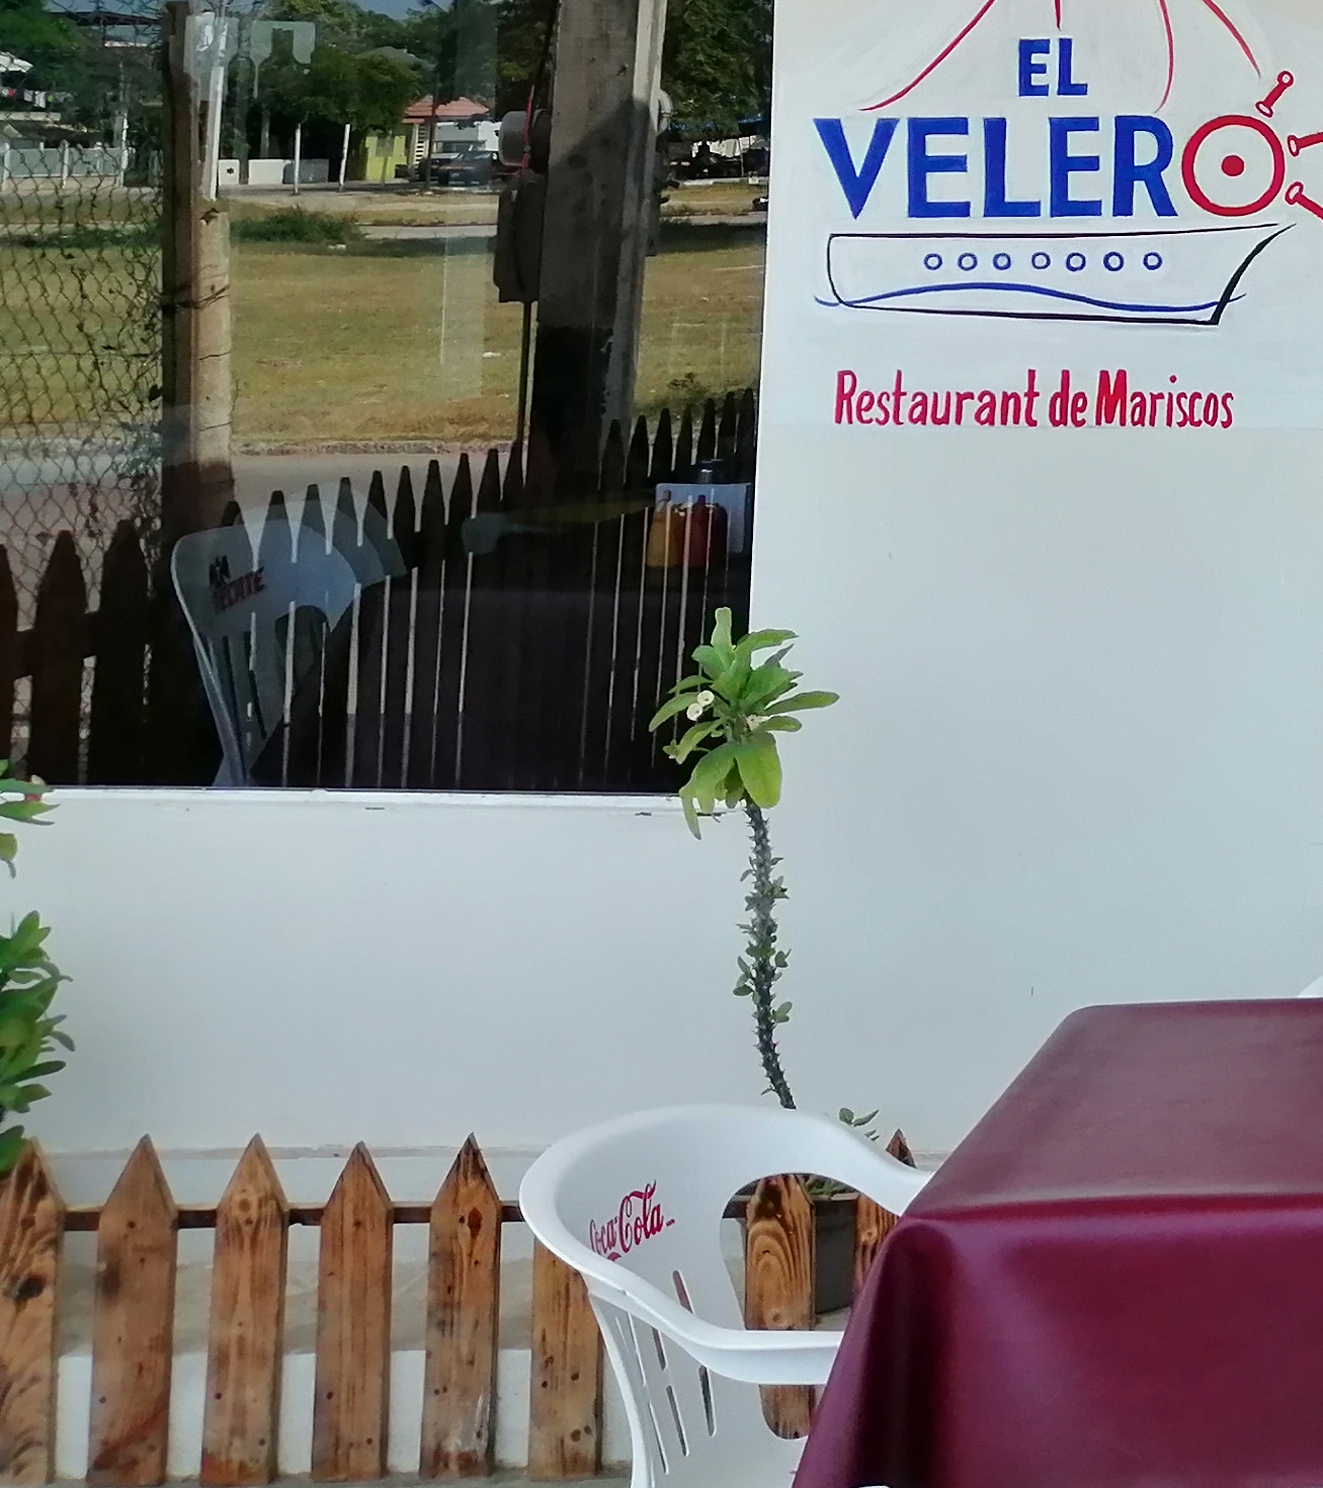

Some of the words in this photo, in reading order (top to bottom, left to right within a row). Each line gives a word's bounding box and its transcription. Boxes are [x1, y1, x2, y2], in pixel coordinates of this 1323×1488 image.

[1018, 38, 1088, 97] EL
[813, 114, 1286, 220] VELERO
[834, 369, 1038, 428] Restaurant
[1049, 369, 1089, 429] de
[1095, 369, 1234, 429] Mariscos
